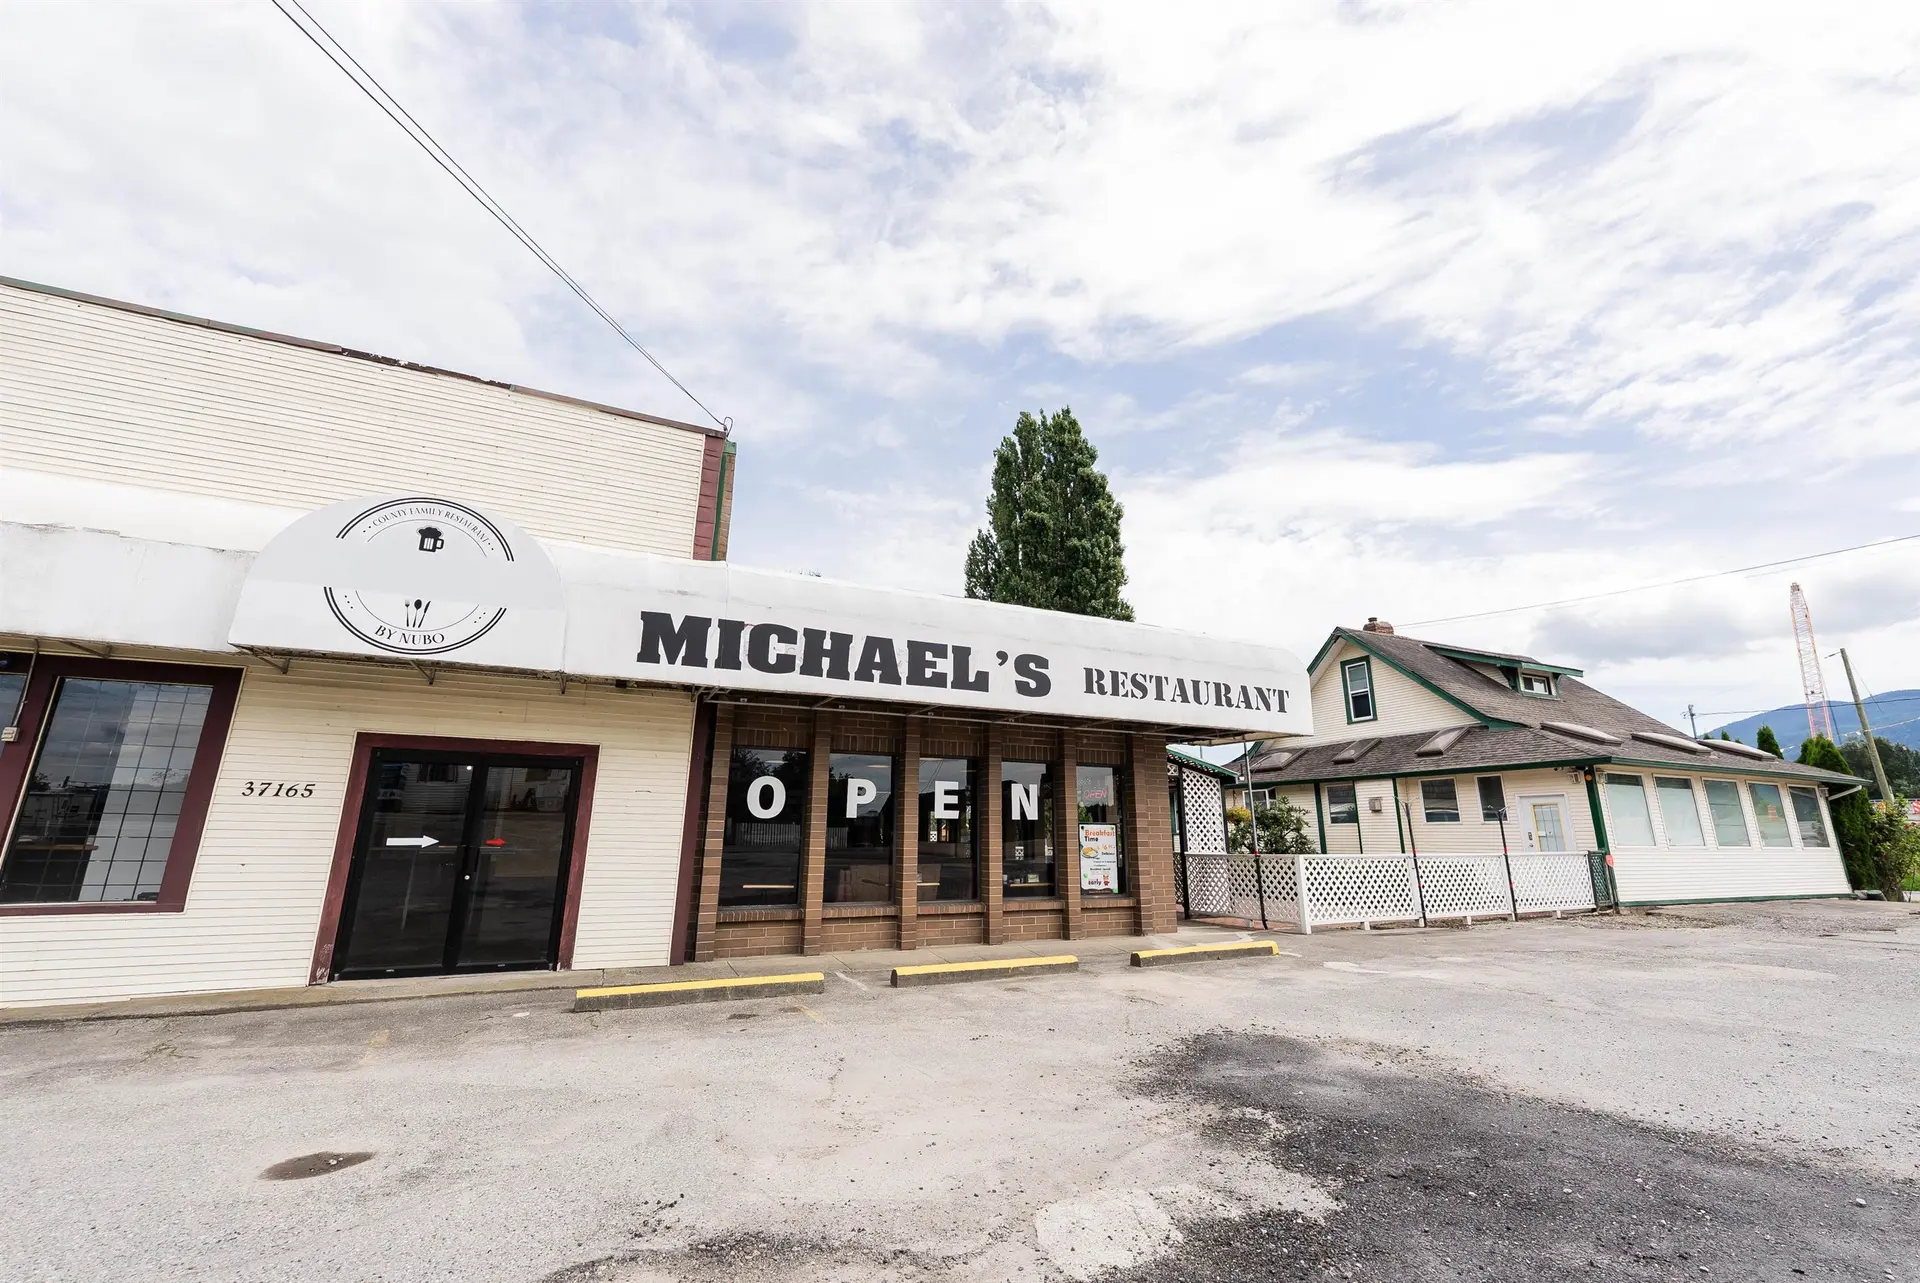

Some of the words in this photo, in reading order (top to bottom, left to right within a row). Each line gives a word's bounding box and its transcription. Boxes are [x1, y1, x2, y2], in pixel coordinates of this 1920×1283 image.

[372, 508, 409, 527] COUNTY
[409, 507, 444, 517] FAMILY
[444, 511, 489, 543] RESTAURANT
[374, 624, 398, 641] BY
[398, 632, 445, 645] NUBO
[636, 610, 1052, 698] MICHAEL'S
[1083, 667, 1288, 714] RESTAURANT
[241, 781, 317, 798] 37165
[1084, 789, 1108, 799] OPEN
[1084, 829, 1116, 837] Breakfast
